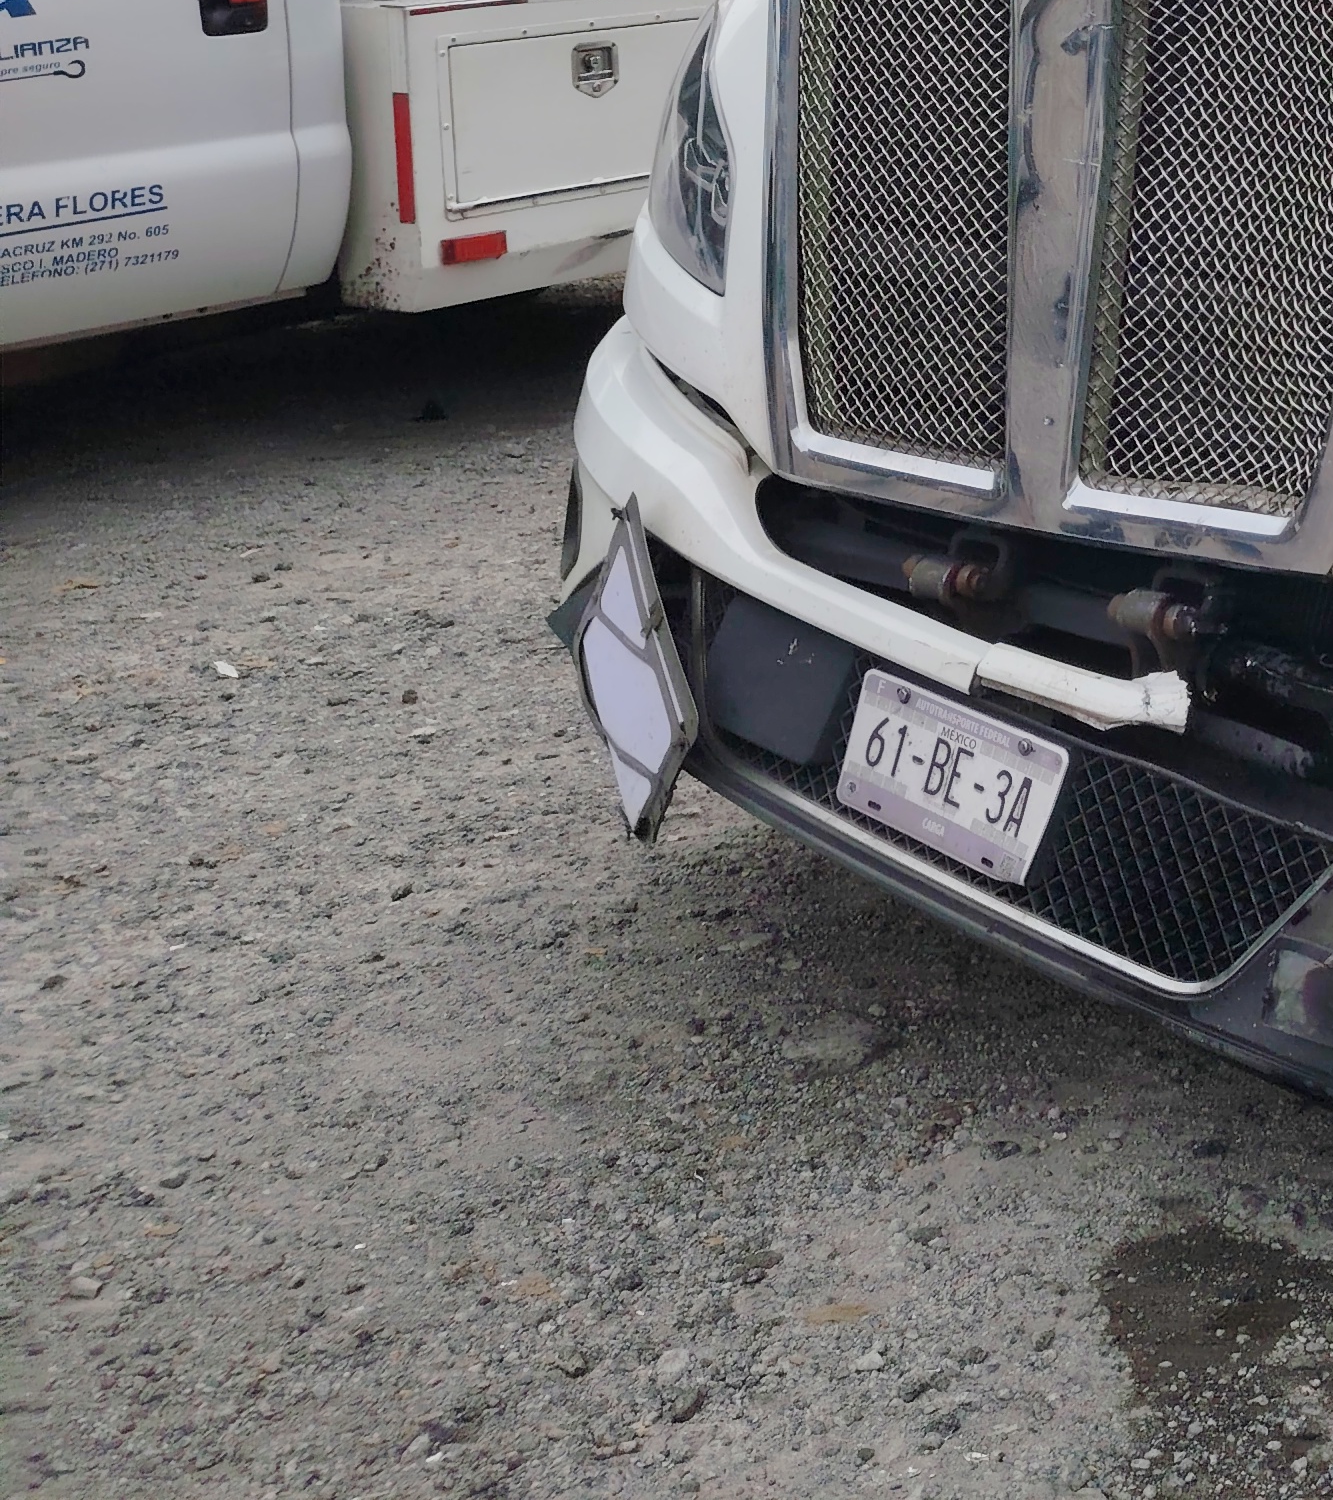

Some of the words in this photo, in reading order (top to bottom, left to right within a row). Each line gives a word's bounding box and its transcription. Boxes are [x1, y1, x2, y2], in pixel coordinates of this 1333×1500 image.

[22, 61, 61, 73] seguro
[55, 184, 164, 217] FLORES
[60, 236, 84, 250] KM
[117, 229, 140, 243] No.
[145, 224, 170, 238] 605
[52, 247, 119, 268] MADERO
[85, 257, 120, 276] (271)
[124, 249, 180, 268] 7321179
[877, 679, 887, 694] F
[916, 698, 980, 734] AUTOTRANSPORTE
[979, 726, 1011, 748] FEDERAL
[866, 717, 1033, 838] 61-BE-3A
[922, 817, 946, 838] CARGA
